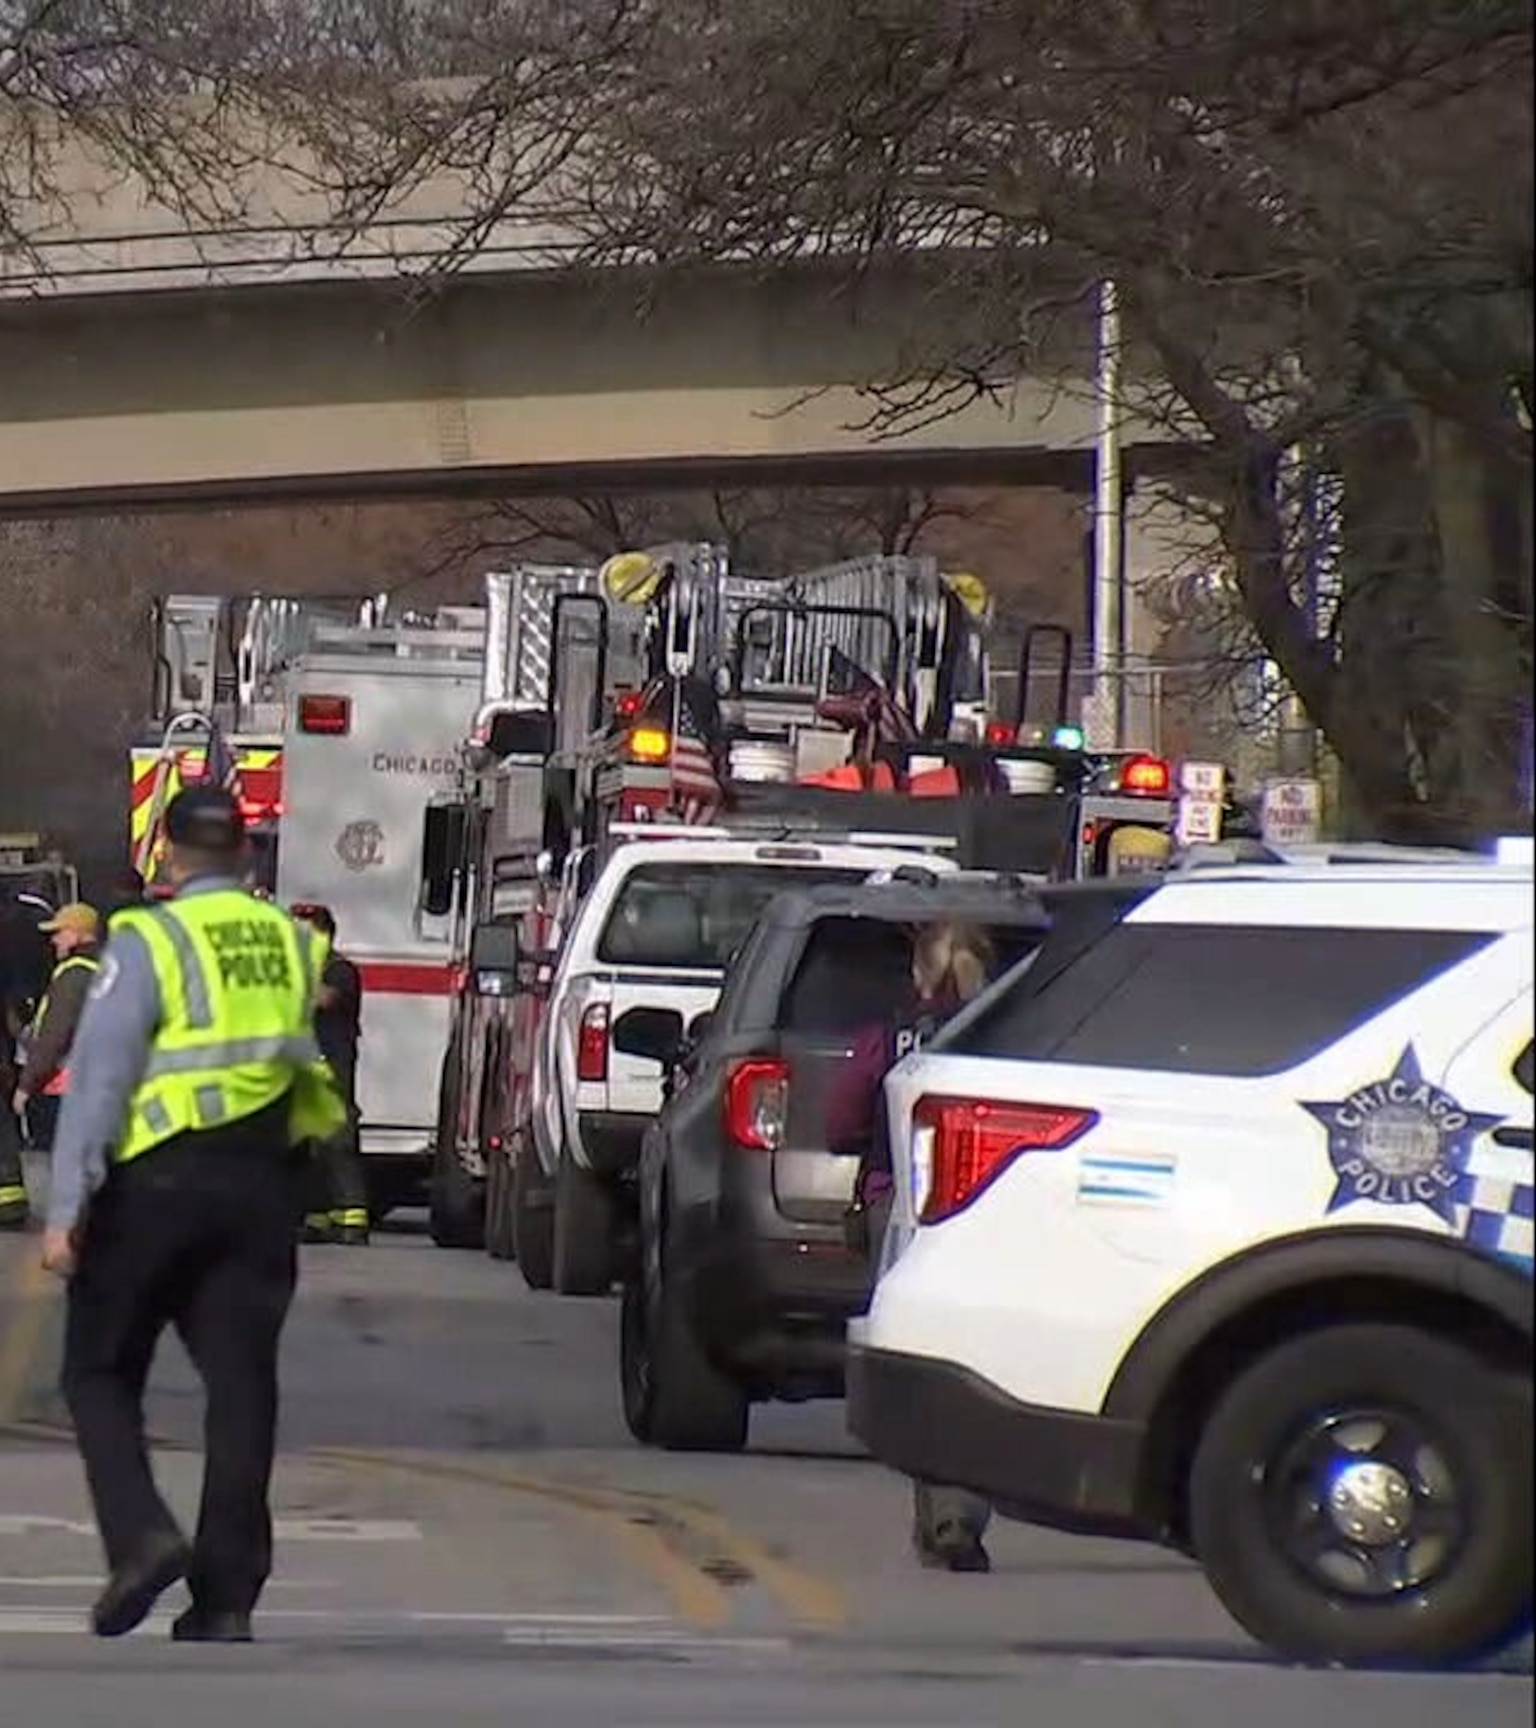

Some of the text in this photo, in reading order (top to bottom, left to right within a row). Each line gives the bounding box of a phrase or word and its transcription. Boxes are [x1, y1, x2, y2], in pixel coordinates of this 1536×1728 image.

[372, 752, 457, 776] CHICAGO
[202, 919, 285, 951] CHICAGO
[216, 950, 292, 991] POLICE
[1336, 1078, 1468, 1130] CHICAGO
[1338, 1158, 1458, 1203] POLICE
